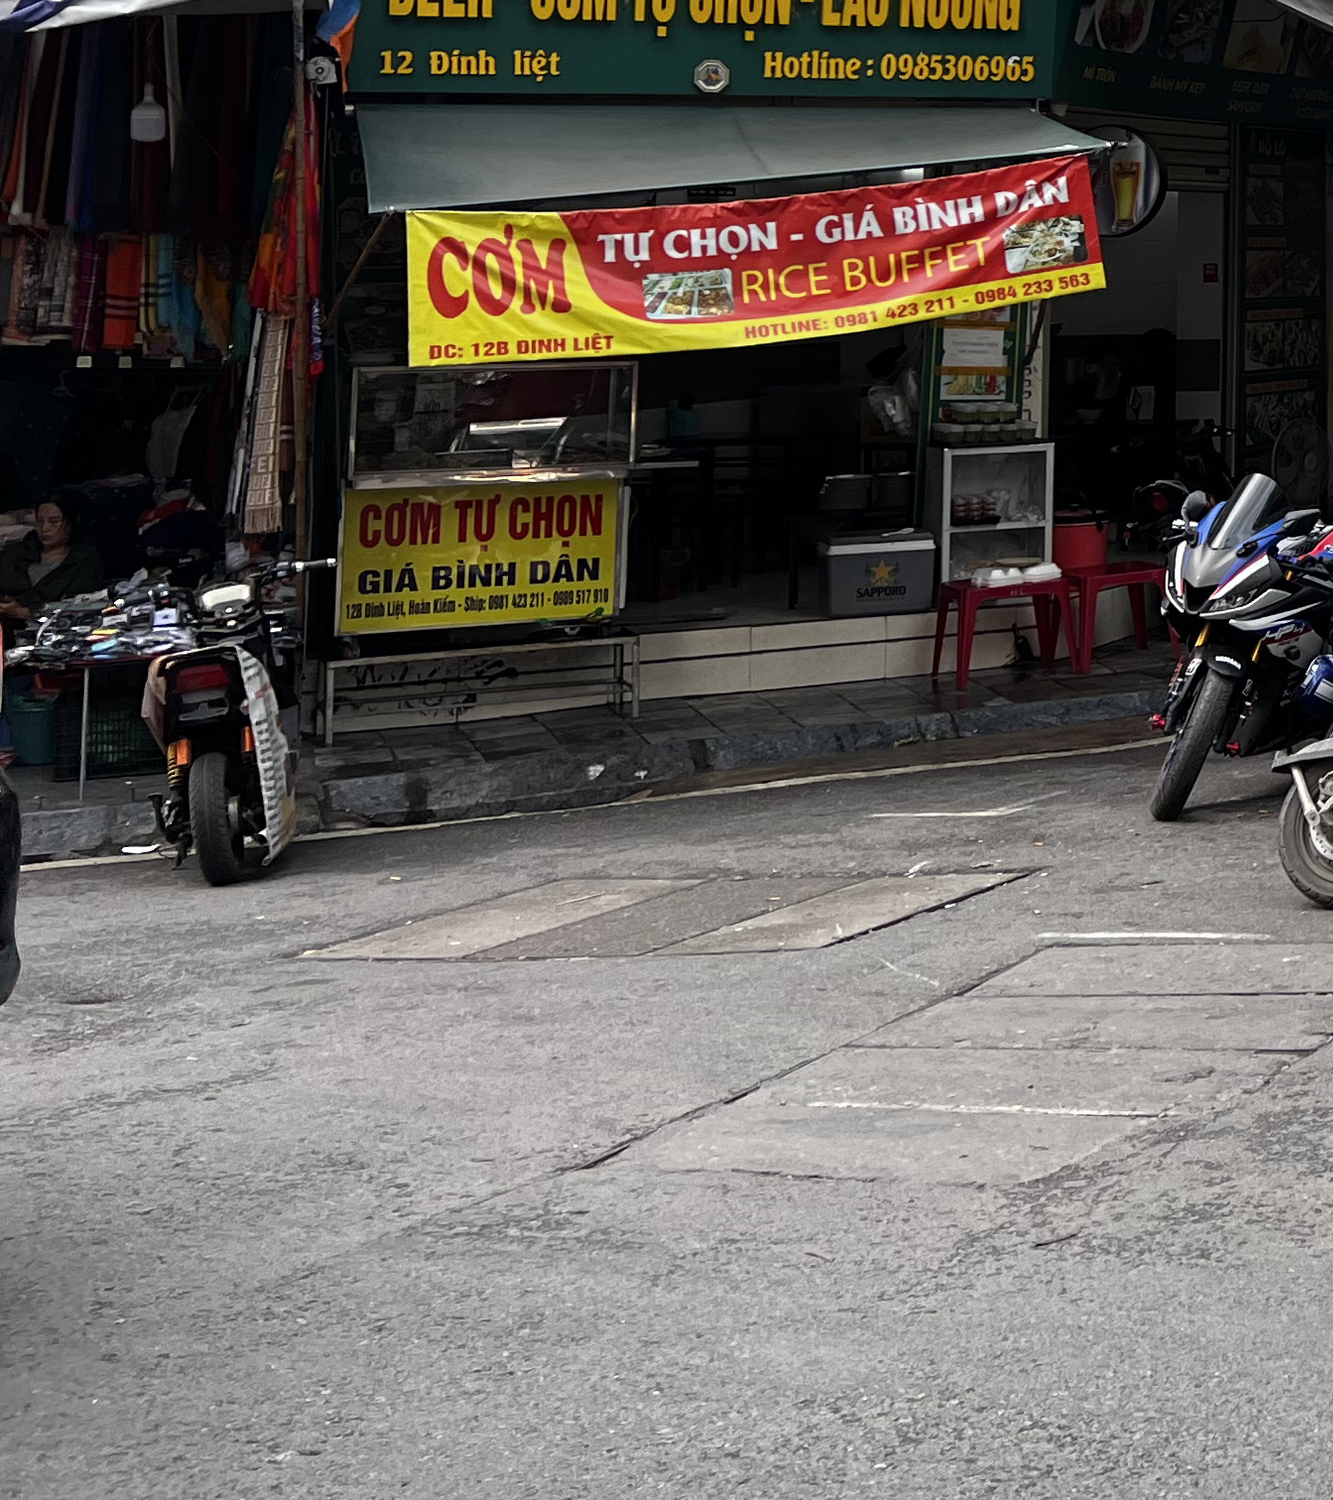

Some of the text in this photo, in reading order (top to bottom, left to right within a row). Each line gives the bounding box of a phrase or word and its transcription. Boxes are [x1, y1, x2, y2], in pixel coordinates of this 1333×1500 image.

[379, 50, 414, 75] 12
[513, 49, 561, 82] liệt
[762, 50, 861, 80] Hotline
[880, 52, 1035, 83] 0985306965
[596, 229, 655, 268] TỰ
[662, 220, 779, 262] CHỌN
[814, 204, 884, 244] GIÁ
[892, 197, 985, 237] BÌNH
[994, 175, 1071, 219] DÂN
[426, 223, 573, 319] CƠM
[741, 235, 992, 304] RICE BUFFET
[744, 317, 829, 340] HOTLINE:
[834, 308, 879, 329] 0981
[885, 302, 920, 320] 423
[925, 296, 956, 315] 211
[973, 286, 1018, 306] 0984
[1022, 278, 1054, 297] 233
[470, 341, 510, 358] 12B
[516, 337, 567, 355] ĐINH
[573, 332, 615, 355] LIỆT
[358, 493, 604, 553] CƠM TỰ CHỌN
[357, 553, 601, 596] GIÁ BÌNH DÂN
[856, 585, 907, 599] SAPPORO
